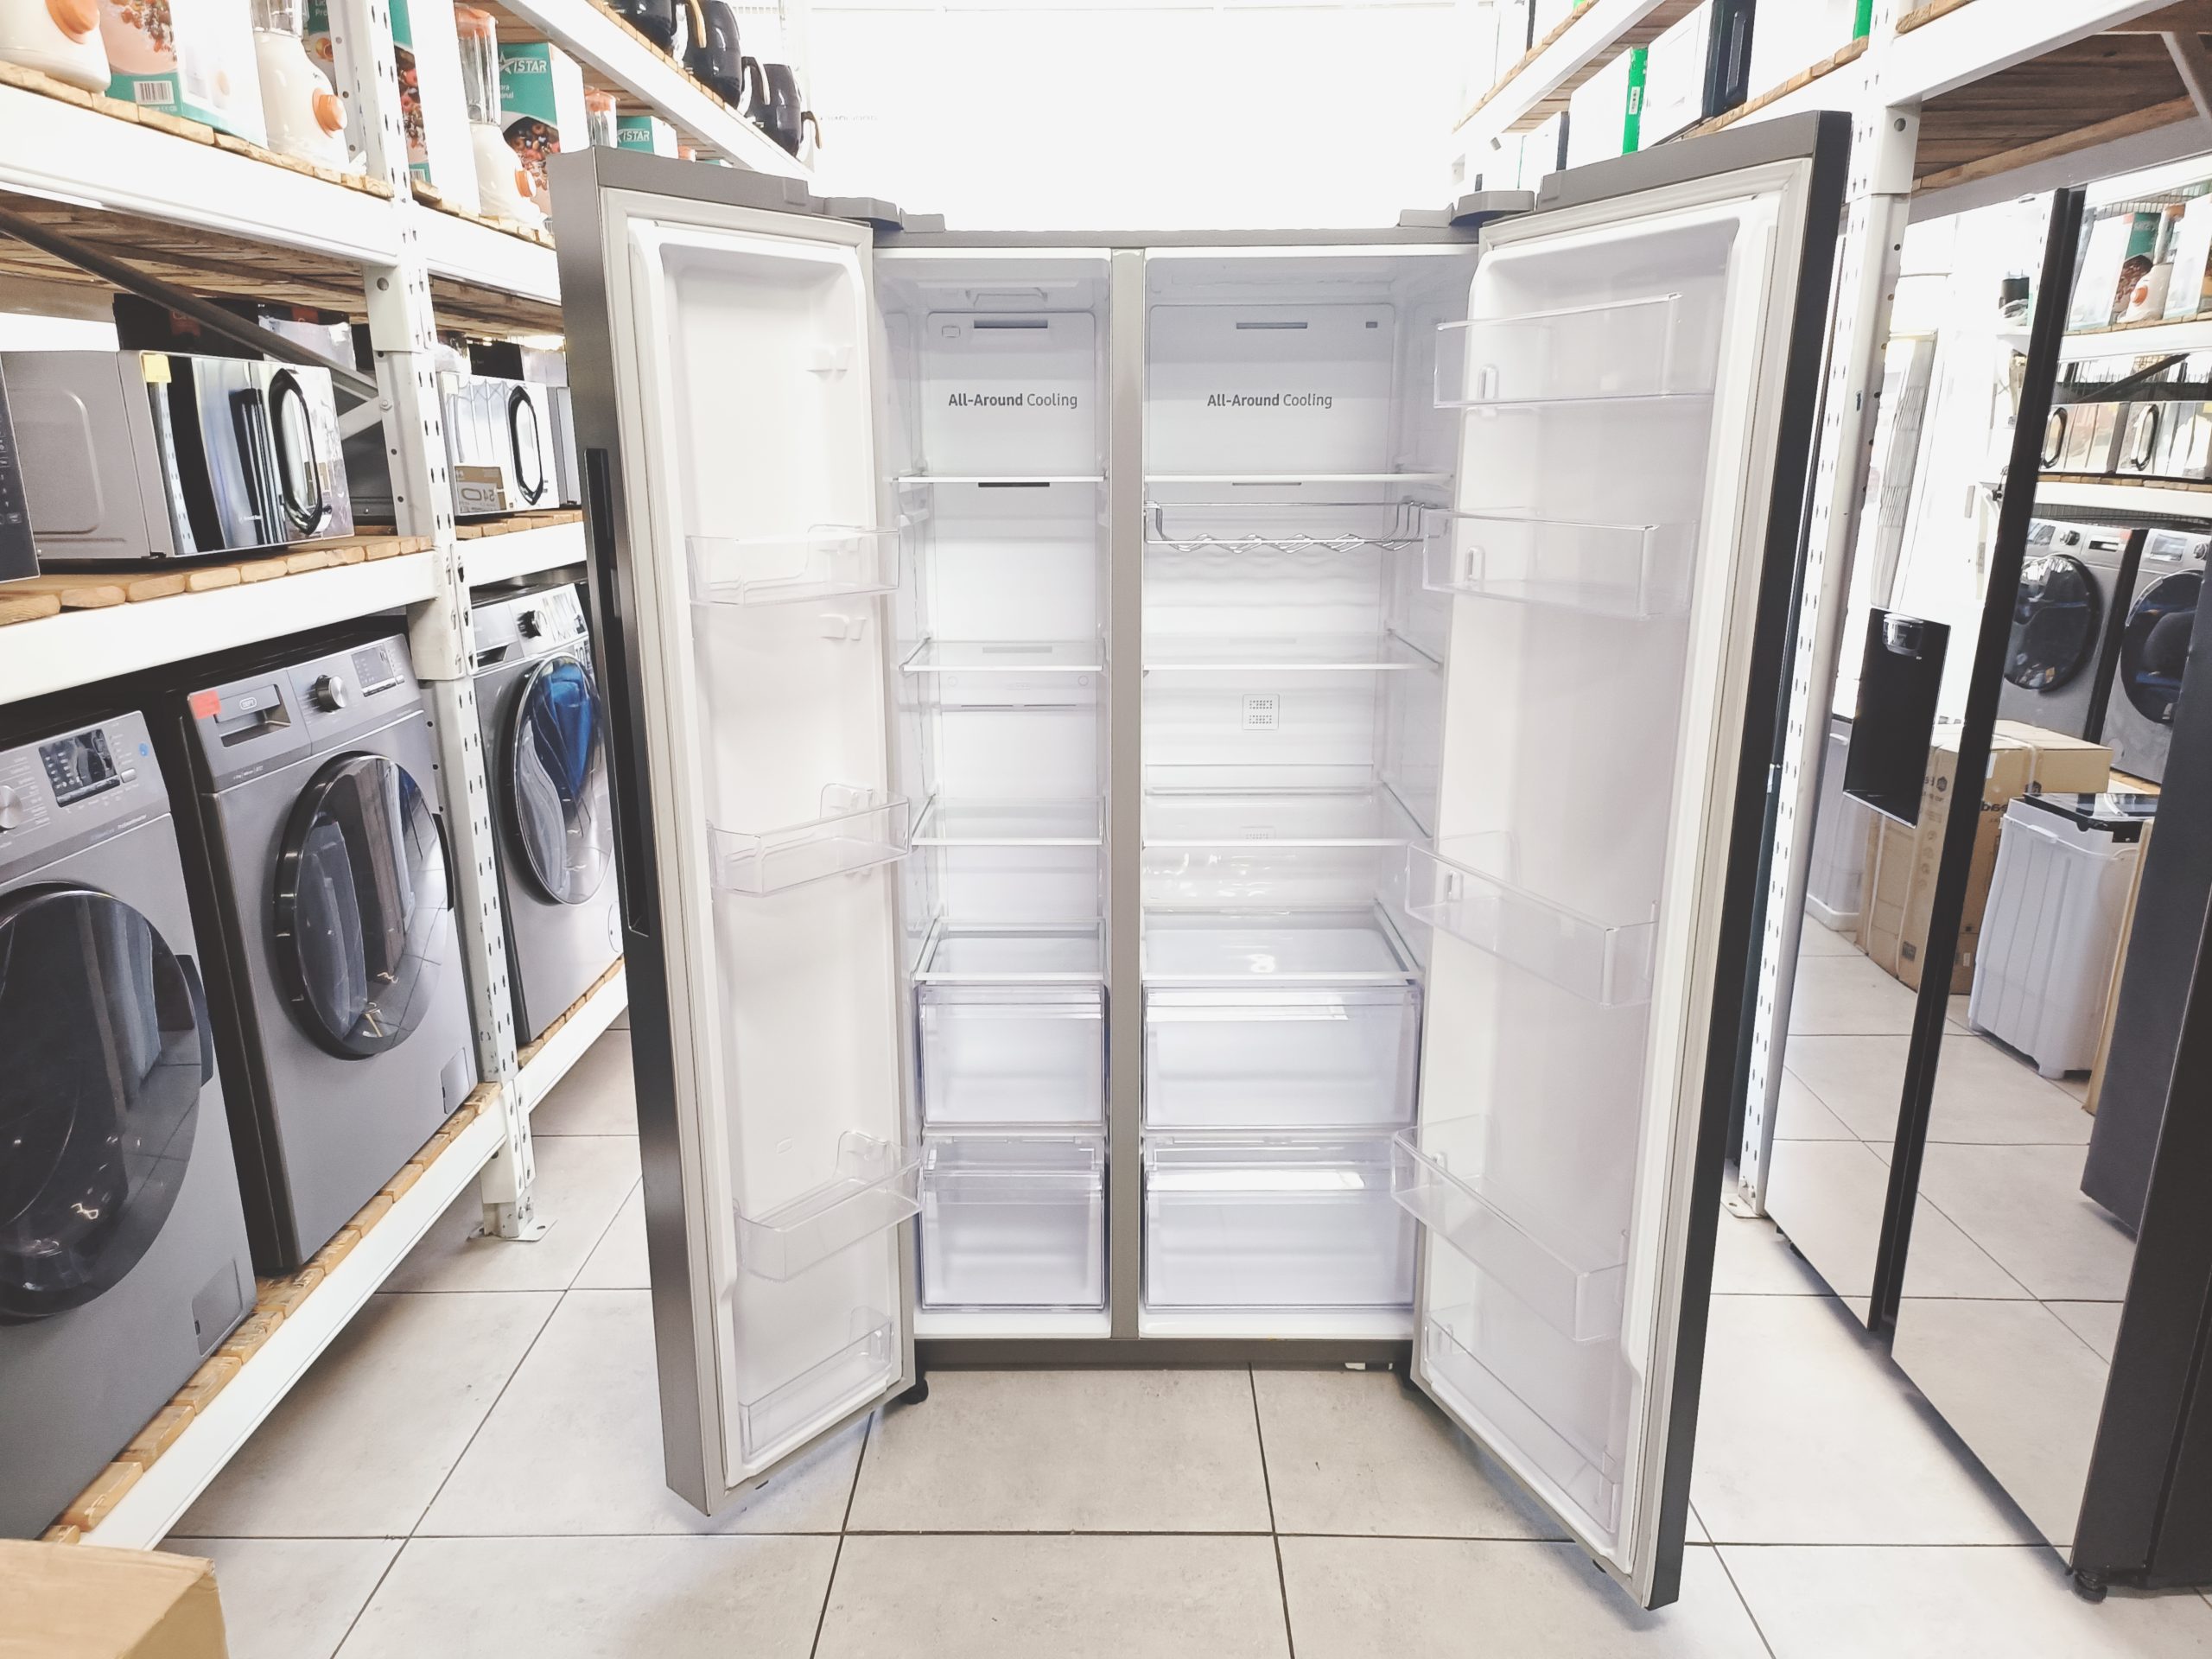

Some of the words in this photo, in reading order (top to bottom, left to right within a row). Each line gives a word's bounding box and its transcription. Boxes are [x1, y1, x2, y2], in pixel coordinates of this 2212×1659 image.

[948, 393, 1023, 406] All-Around
[1027, 393, 1077, 409] Cooling
[1207, 393, 1280, 406] All-Around
[1283, 393, 1332, 409] Cooling
